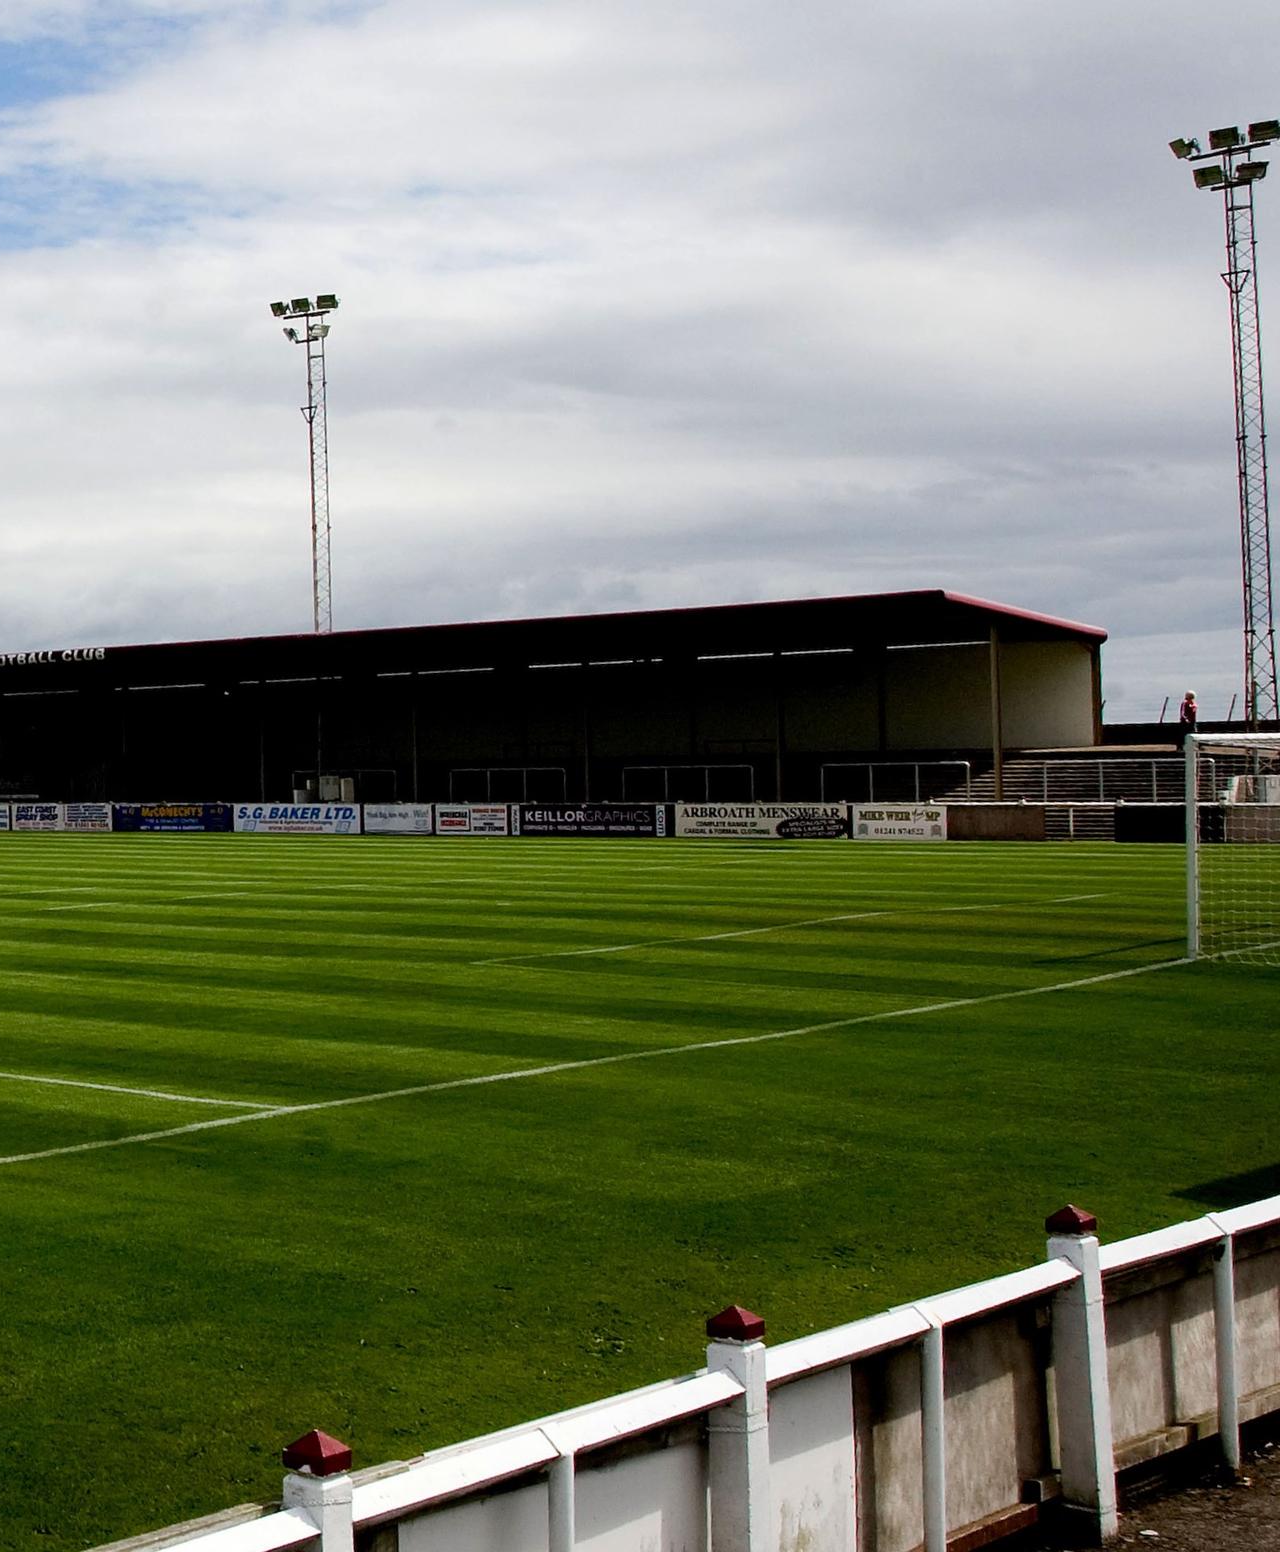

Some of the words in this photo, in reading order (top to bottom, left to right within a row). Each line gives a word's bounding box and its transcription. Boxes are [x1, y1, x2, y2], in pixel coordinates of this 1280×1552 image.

[62, 648, 106, 662] CLUB
[238, 807, 266, 819] S.G.
[269, 807, 320, 819] BAKER
[324, 807, 356, 819] LTD.
[681, 807, 755, 818] ARBROATH
[758, 807, 840, 818] MENSWEAR
[859, 811, 885, 820] MIKE
[886, 811, 911, 821] WEIR
[925, 811, 940, 821] MP
